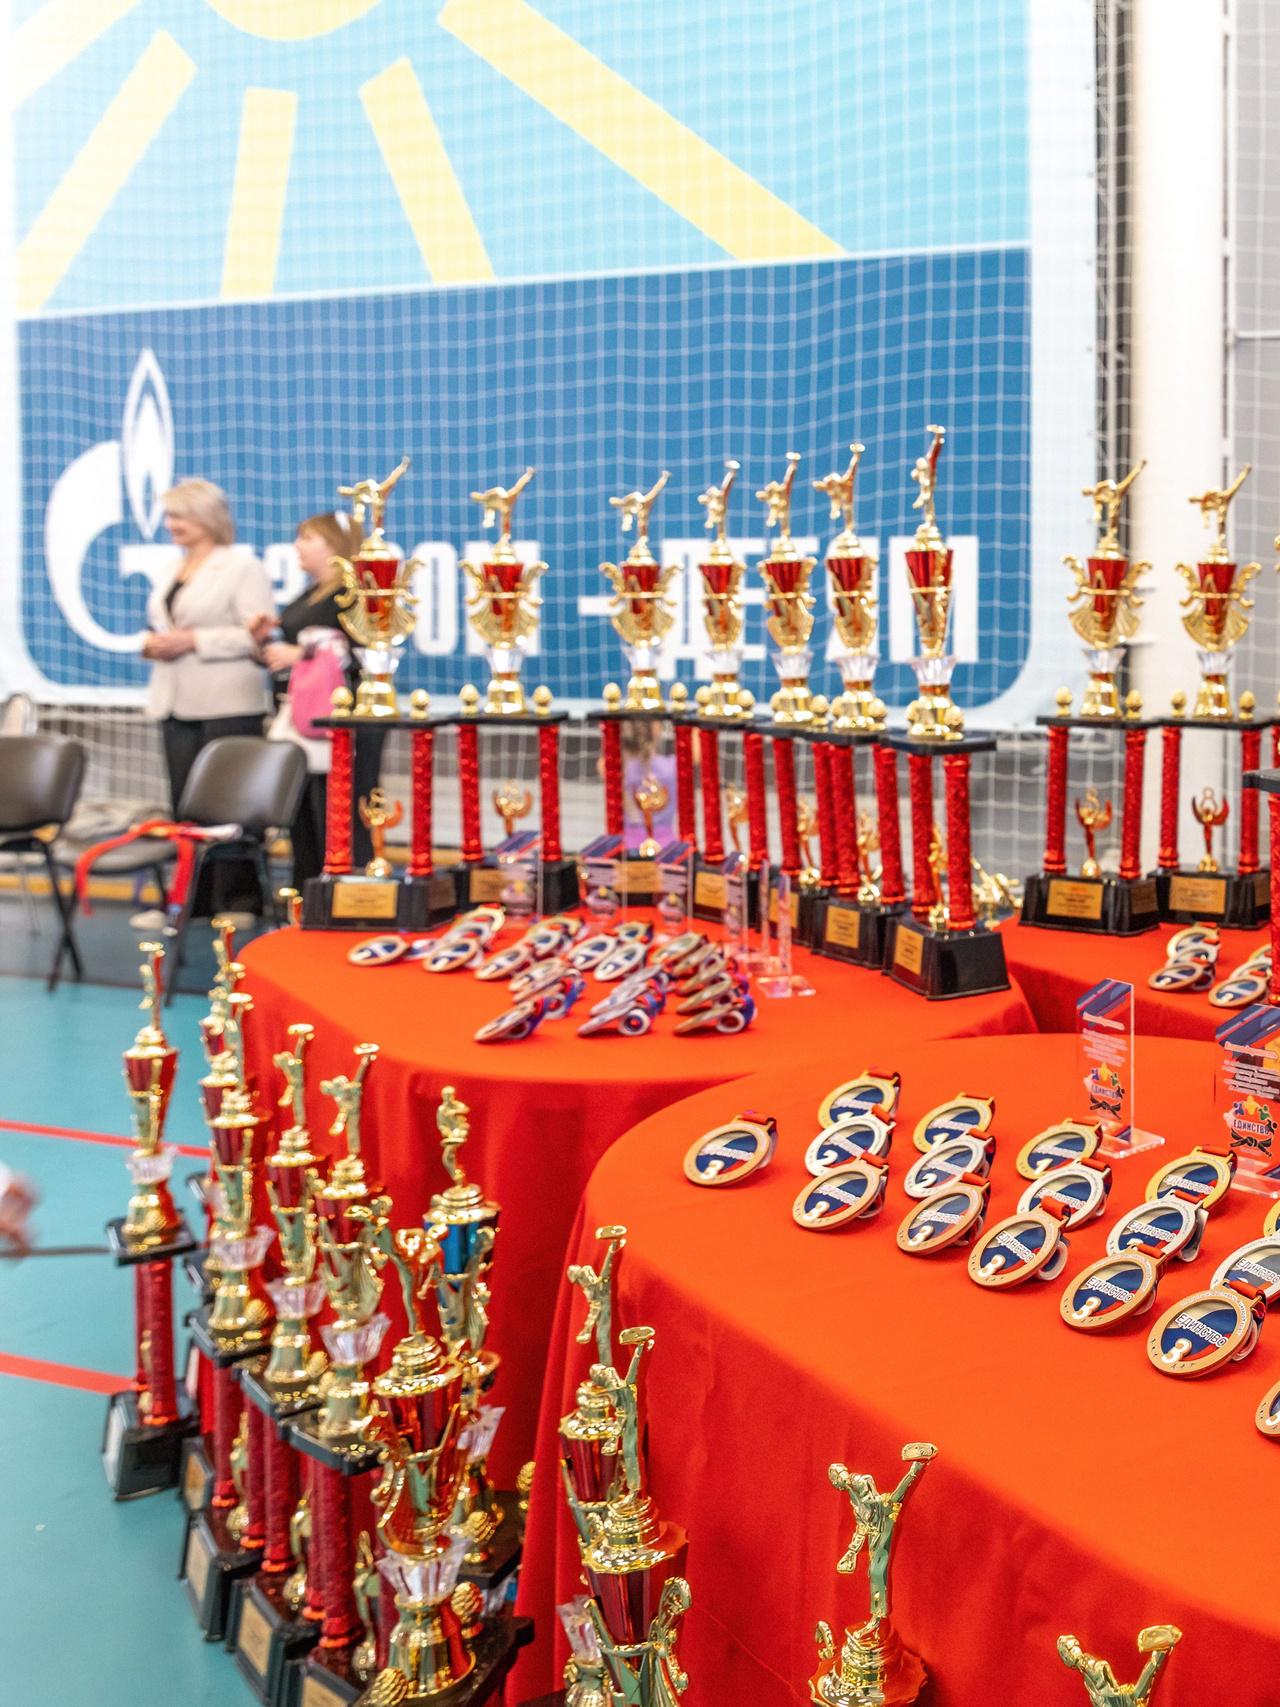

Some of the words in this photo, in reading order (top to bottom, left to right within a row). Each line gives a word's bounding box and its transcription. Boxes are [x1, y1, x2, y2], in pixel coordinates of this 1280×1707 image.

[907, 1225, 935, 1246] 3
[977, 1254, 1006, 1277] 3
[1085, 1275, 1136, 1303] ЕДИНСТВО
[1072, 1297, 1102, 1319] 3
[1175, 1312, 1229, 1347] ЕДИНСТВО
[1161, 1337, 1192, 1364] 3
